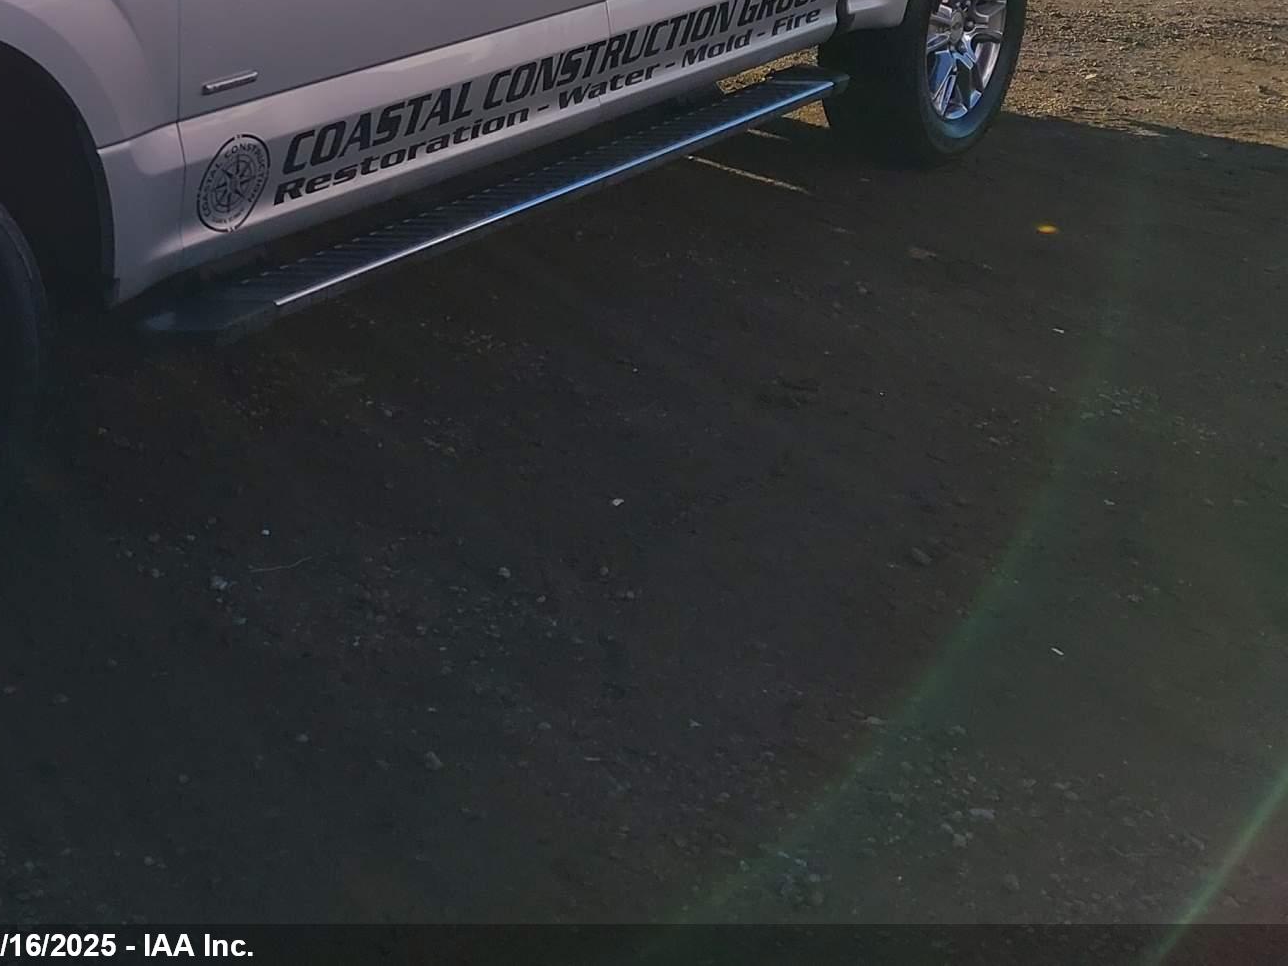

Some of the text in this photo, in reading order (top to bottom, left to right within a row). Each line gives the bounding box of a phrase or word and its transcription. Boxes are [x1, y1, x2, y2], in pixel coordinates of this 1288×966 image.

[273, 105, 530, 206] Restoration
[558, 63, 661, 110] Water
[681, 28, 753, 68] Mold
[771, 8, 822, 36] Fire
[283, 81, 473, 175] COASTAL
